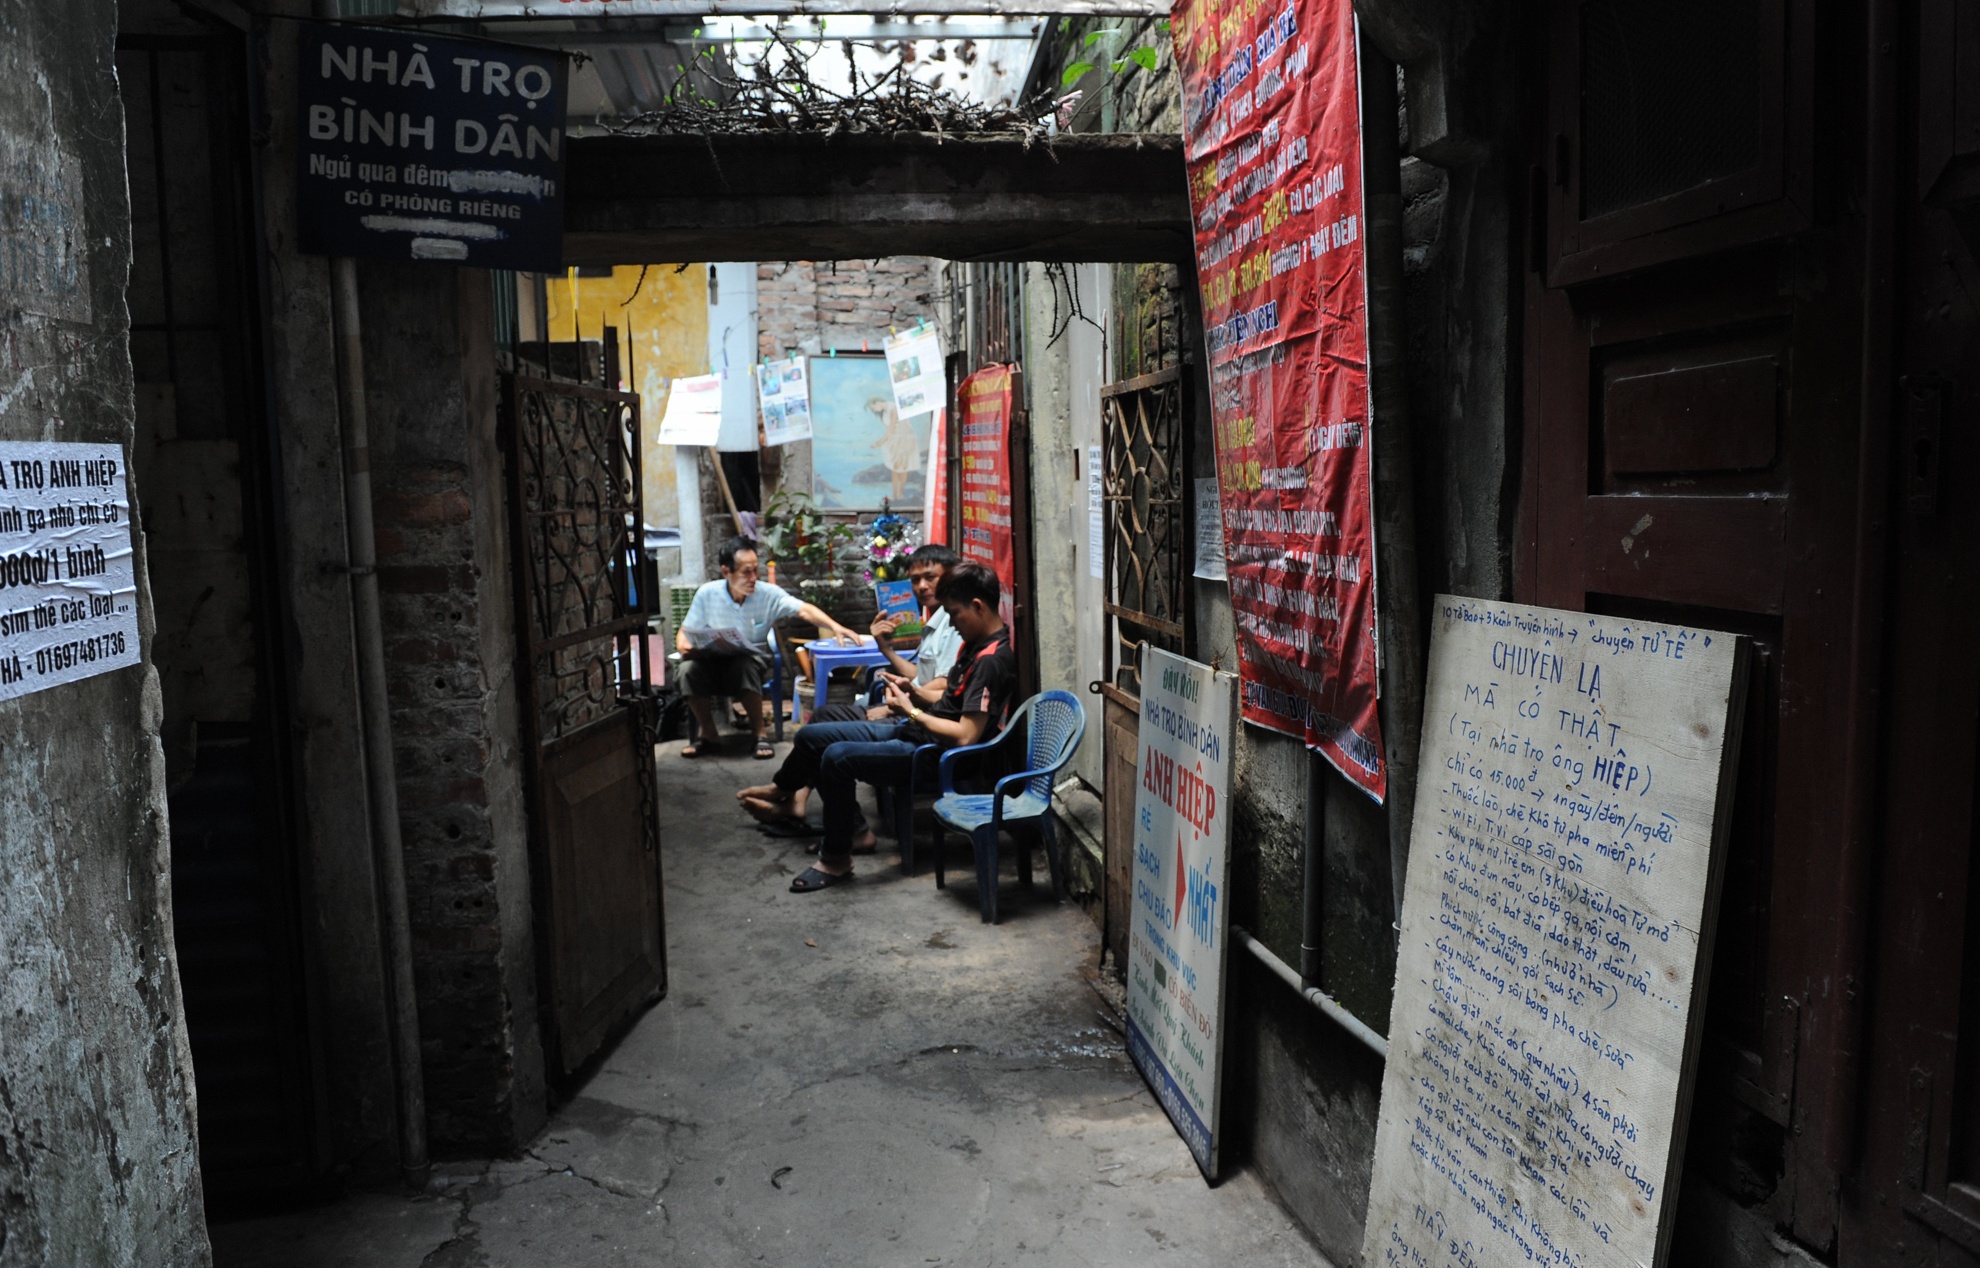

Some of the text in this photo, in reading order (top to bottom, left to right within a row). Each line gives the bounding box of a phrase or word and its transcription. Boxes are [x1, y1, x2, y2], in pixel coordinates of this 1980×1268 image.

[321, 43, 551, 109] NHÀ TRỌ
[1228, 45, 1253, 91] DÂN
[309, 97, 560, 161] BÌNH DÂN
[310, 154, 351, 180] Ngủ
[358, 162, 397, 183] qua
[404, 163, 449, 187] đêm
[1290, 187, 1302, 216] CÓ
[1304, 174, 1323, 210] CÁC
[1324, 163, 1344, 199] LOẠI
[344, 190, 521, 219] CÓ PHÒNG RIÊNG
[1332, 213, 1357, 249] ĐÊM
[10, 460, 44, 495] TRỌ
[50, 460, 81, 488] ANH
[85, 454, 117, 492] HIỆP
[27, 497, 118, 533] ga nhỏ chỉ có
[66, 543, 106, 579] bình
[1, 590, 114, 637] sim thẻ các loại
[1442, 606, 1452, 619] 10
[1543, 617, 1564, 638] hình
[1, 631, 125, 685] HÀ 01697481736
[1162, 667, 1178, 697] ĐÂY
[1492, 640, 1600, 703] CHUYỆN LẠ
[1145, 699, 1220, 763] NHÀ TRỌ BÌNH DÂN
[1518, 691, 1541, 718] CÓ
[1559, 709, 1620, 754] THẬT
[1447, 751, 1482, 779] chỉ có
[1552, 743, 1583, 785] ông
[1143, 744, 1216, 841] ANH HIỆP
[1451, 782, 1655, 875] Thuốc chè tự pha miễn phí
[1511, 827, 1582, 873] cáp gòn
[1138, 842, 1160, 880] SẠCH
[1468, 838, 1603, 912] phụ trẻ em điều
[1137, 880, 1172, 931] CHU ĐÁO
[1187, 857, 1217, 949] NHẤT
[1440, 891, 1461, 914] Phích
[1485, 921, 1505, 947] công
[1479, 863, 1497, 881] đun
[1527, 886, 1539, 904] có
[1541, 891, 1560, 916] bếp
[1584, 917, 1603, 937] nồi
[1144, 919, 1197, 991] TRONG KHU VỰC
[1503, 897, 1520, 919] bát
[1548, 925, 1569, 946] dao
[1603, 954, 1624, 979] dầu
[1455, 951, 1480, 972] nước
[1480, 965, 1504, 994] nóng
[1525, 988, 1548, 1020] bỏng
[1552, 1011, 1574, 1036] pha
[1522, 957, 1539, 979] gối
[1437, 1010, 1453, 1027] mái
[1554, 1103, 1578, 1131] mưa
[1580, 1123, 1590, 1140] có
[1625, 1164, 1654, 1201] chạy
[1506, 1028, 1518, 1050] áo
[1581, 1090, 1590, 1109] 4
[1612, 1114, 1638, 1142] phơi
[1452, 1066, 1570, 1175] lo xe ôm giá
[1463, 1057, 1482, 1077] xách
[1484, 1070, 1502, 1088] đồ
[1577, 1150, 1600, 1168] về
[1411, 1134, 1534, 1260] hoặc ngác trong
[1468, 1169, 1506, 1208] can thiệp
[1481, 1126, 1498, 1145] còn
[1501, 1137, 1514, 1157] tái
[1549, 1183, 1566, 1204] các
[1569, 1198, 1590, 1221] lần
[1592, 1221, 1613, 1243] và
[1391, 1222, 1409, 1257] ông
[1415, 1205, 1449, 1241] HÃY
